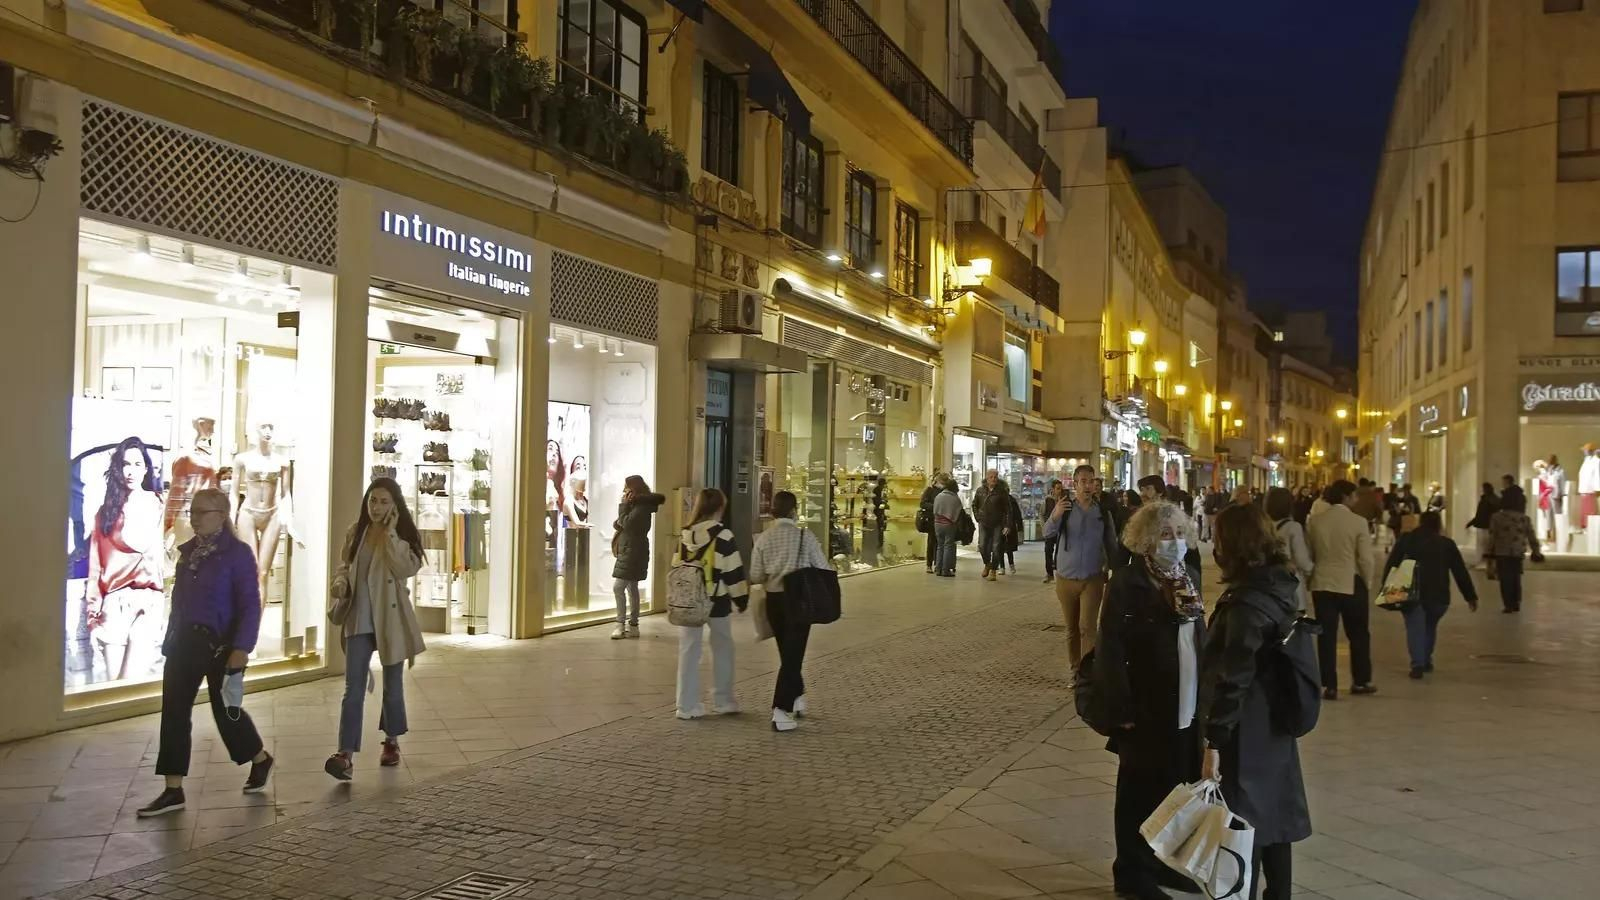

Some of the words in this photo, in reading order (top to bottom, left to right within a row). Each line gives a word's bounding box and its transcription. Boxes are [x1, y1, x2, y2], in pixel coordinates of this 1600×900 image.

[382, 210, 532, 272] intimissimi
[448, 262, 487, 285] Italian
[489, 273, 531, 296] lingerie
